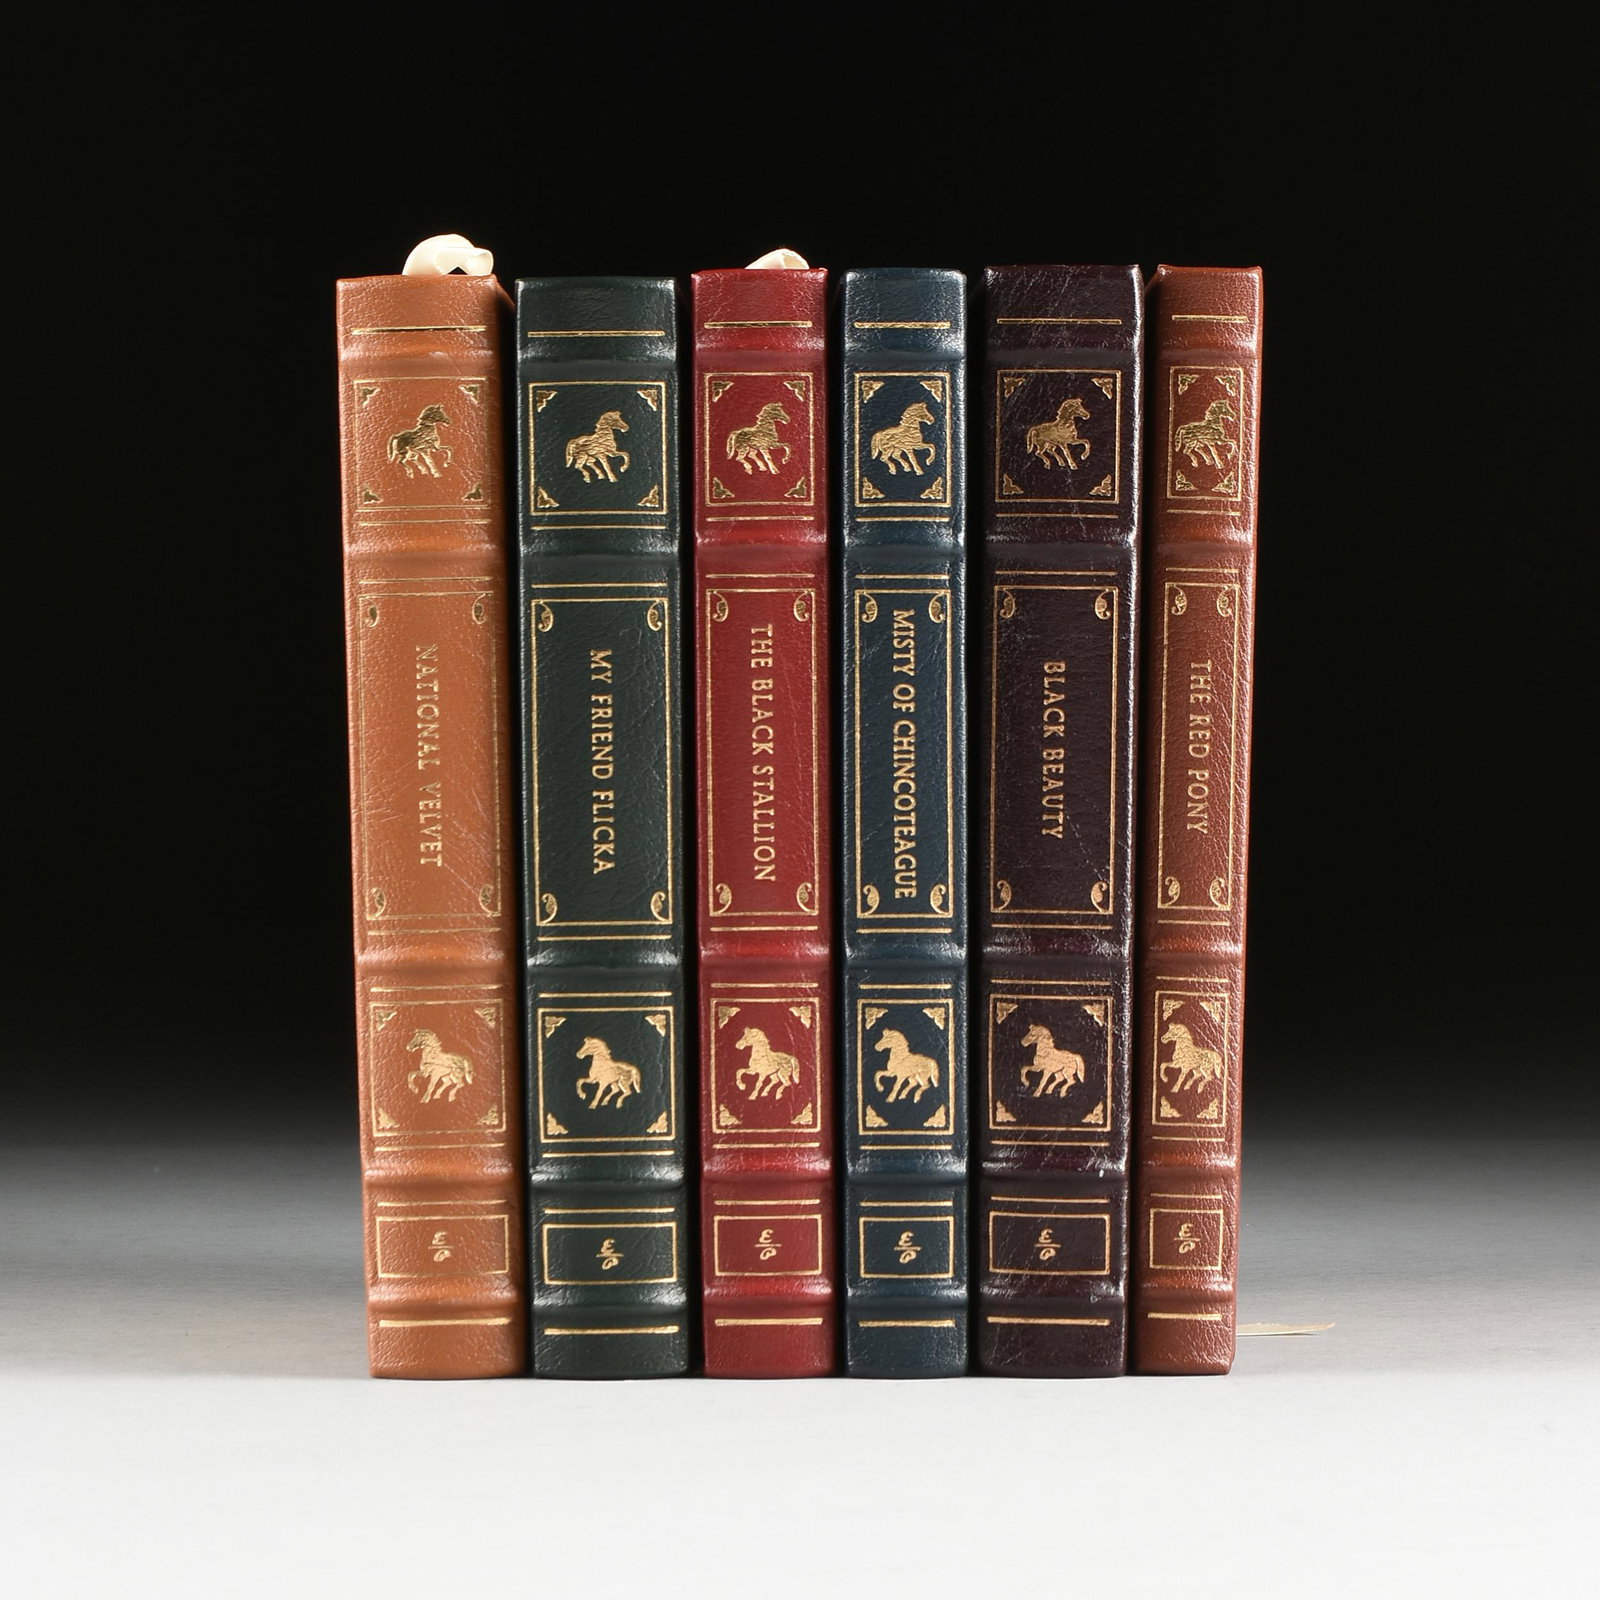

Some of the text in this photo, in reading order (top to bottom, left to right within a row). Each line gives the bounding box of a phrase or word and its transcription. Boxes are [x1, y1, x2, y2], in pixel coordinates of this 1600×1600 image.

[416, 644, 442, 867] NATIONAL VELVET
[591, 649, 615, 874] MY FRIEND FLICKA
[751, 624, 776, 882] THE BLACK STALLION
[892, 609, 917, 898] MISTY OF CHINCOTEAGUE
[1042, 661, 1065, 839] BLACK BEAUTY
[1187, 660, 1211, 834] THE RED PONY
